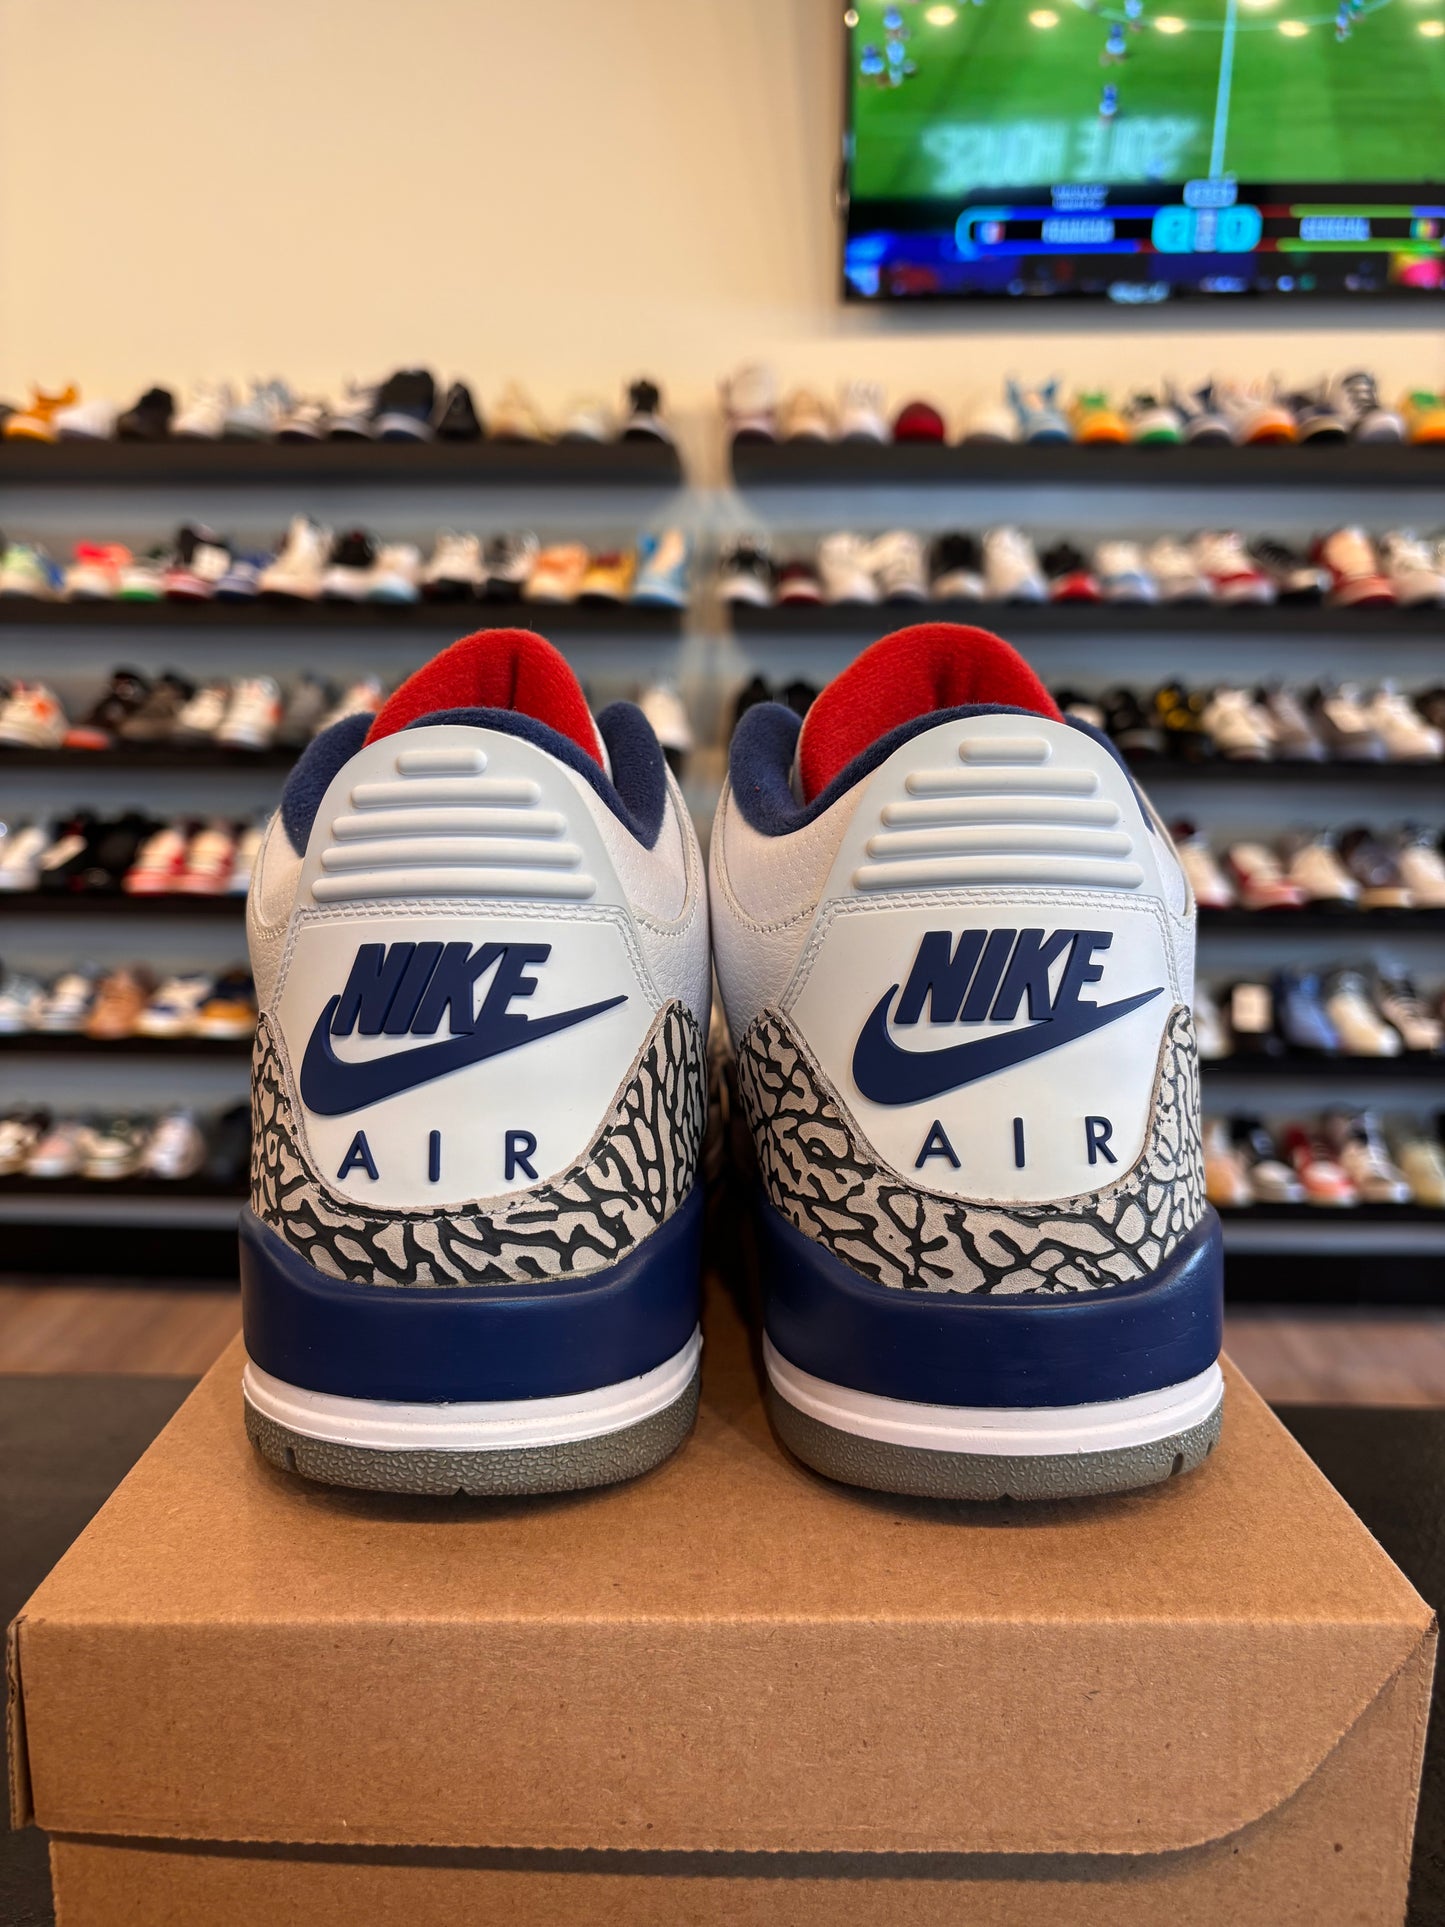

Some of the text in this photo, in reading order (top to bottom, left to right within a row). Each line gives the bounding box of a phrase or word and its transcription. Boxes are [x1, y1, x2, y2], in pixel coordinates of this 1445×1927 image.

[331, 941, 552, 1035] NIKE
[893, 928, 1113, 1023] NIKE
[337, 1130, 539, 1182] AIR
[915, 1115, 1118, 1168] AIR
